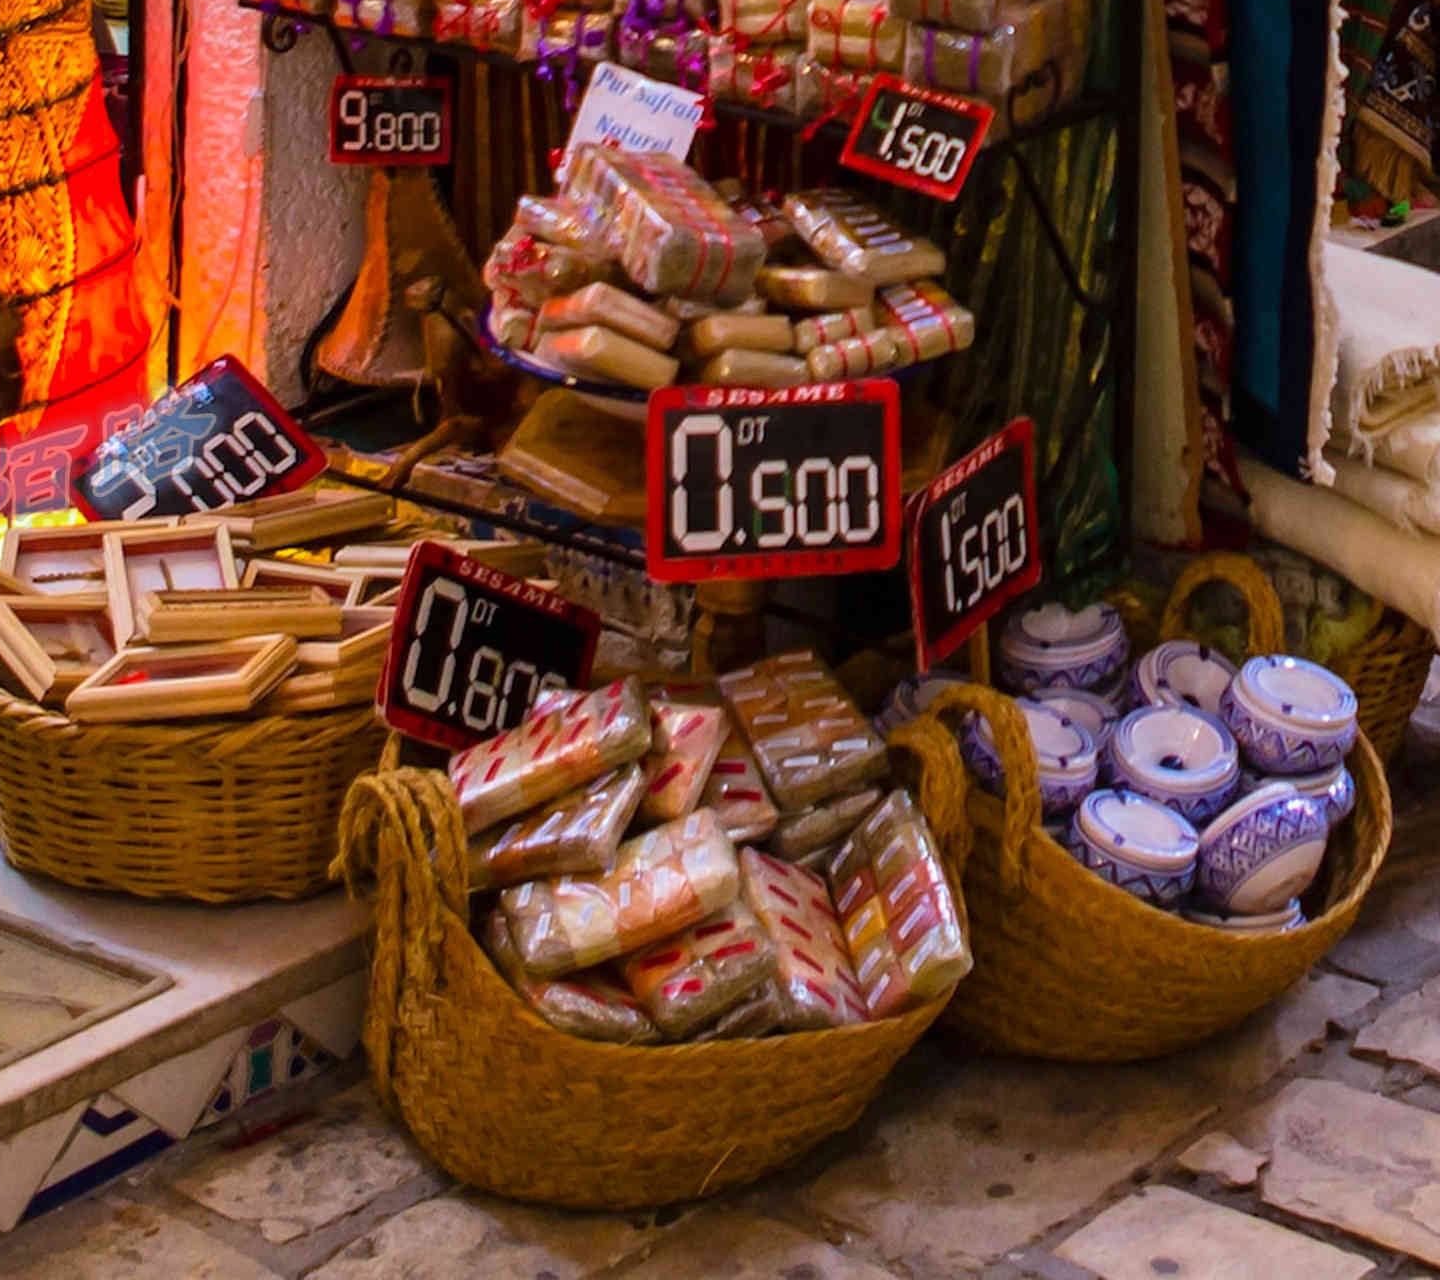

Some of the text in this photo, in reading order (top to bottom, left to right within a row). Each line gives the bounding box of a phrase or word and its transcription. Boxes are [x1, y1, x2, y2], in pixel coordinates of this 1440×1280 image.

[340, 90, 441, 152] 9.800
[705, 383, 847, 407] SESAME
[737, 415, 770, 446] DT
[672, 414, 879, 552] 0.500
[941, 493, 1027, 613] 1.500
[459, 560, 566, 614] SESAME
[471, 597, 500, 627] DT
